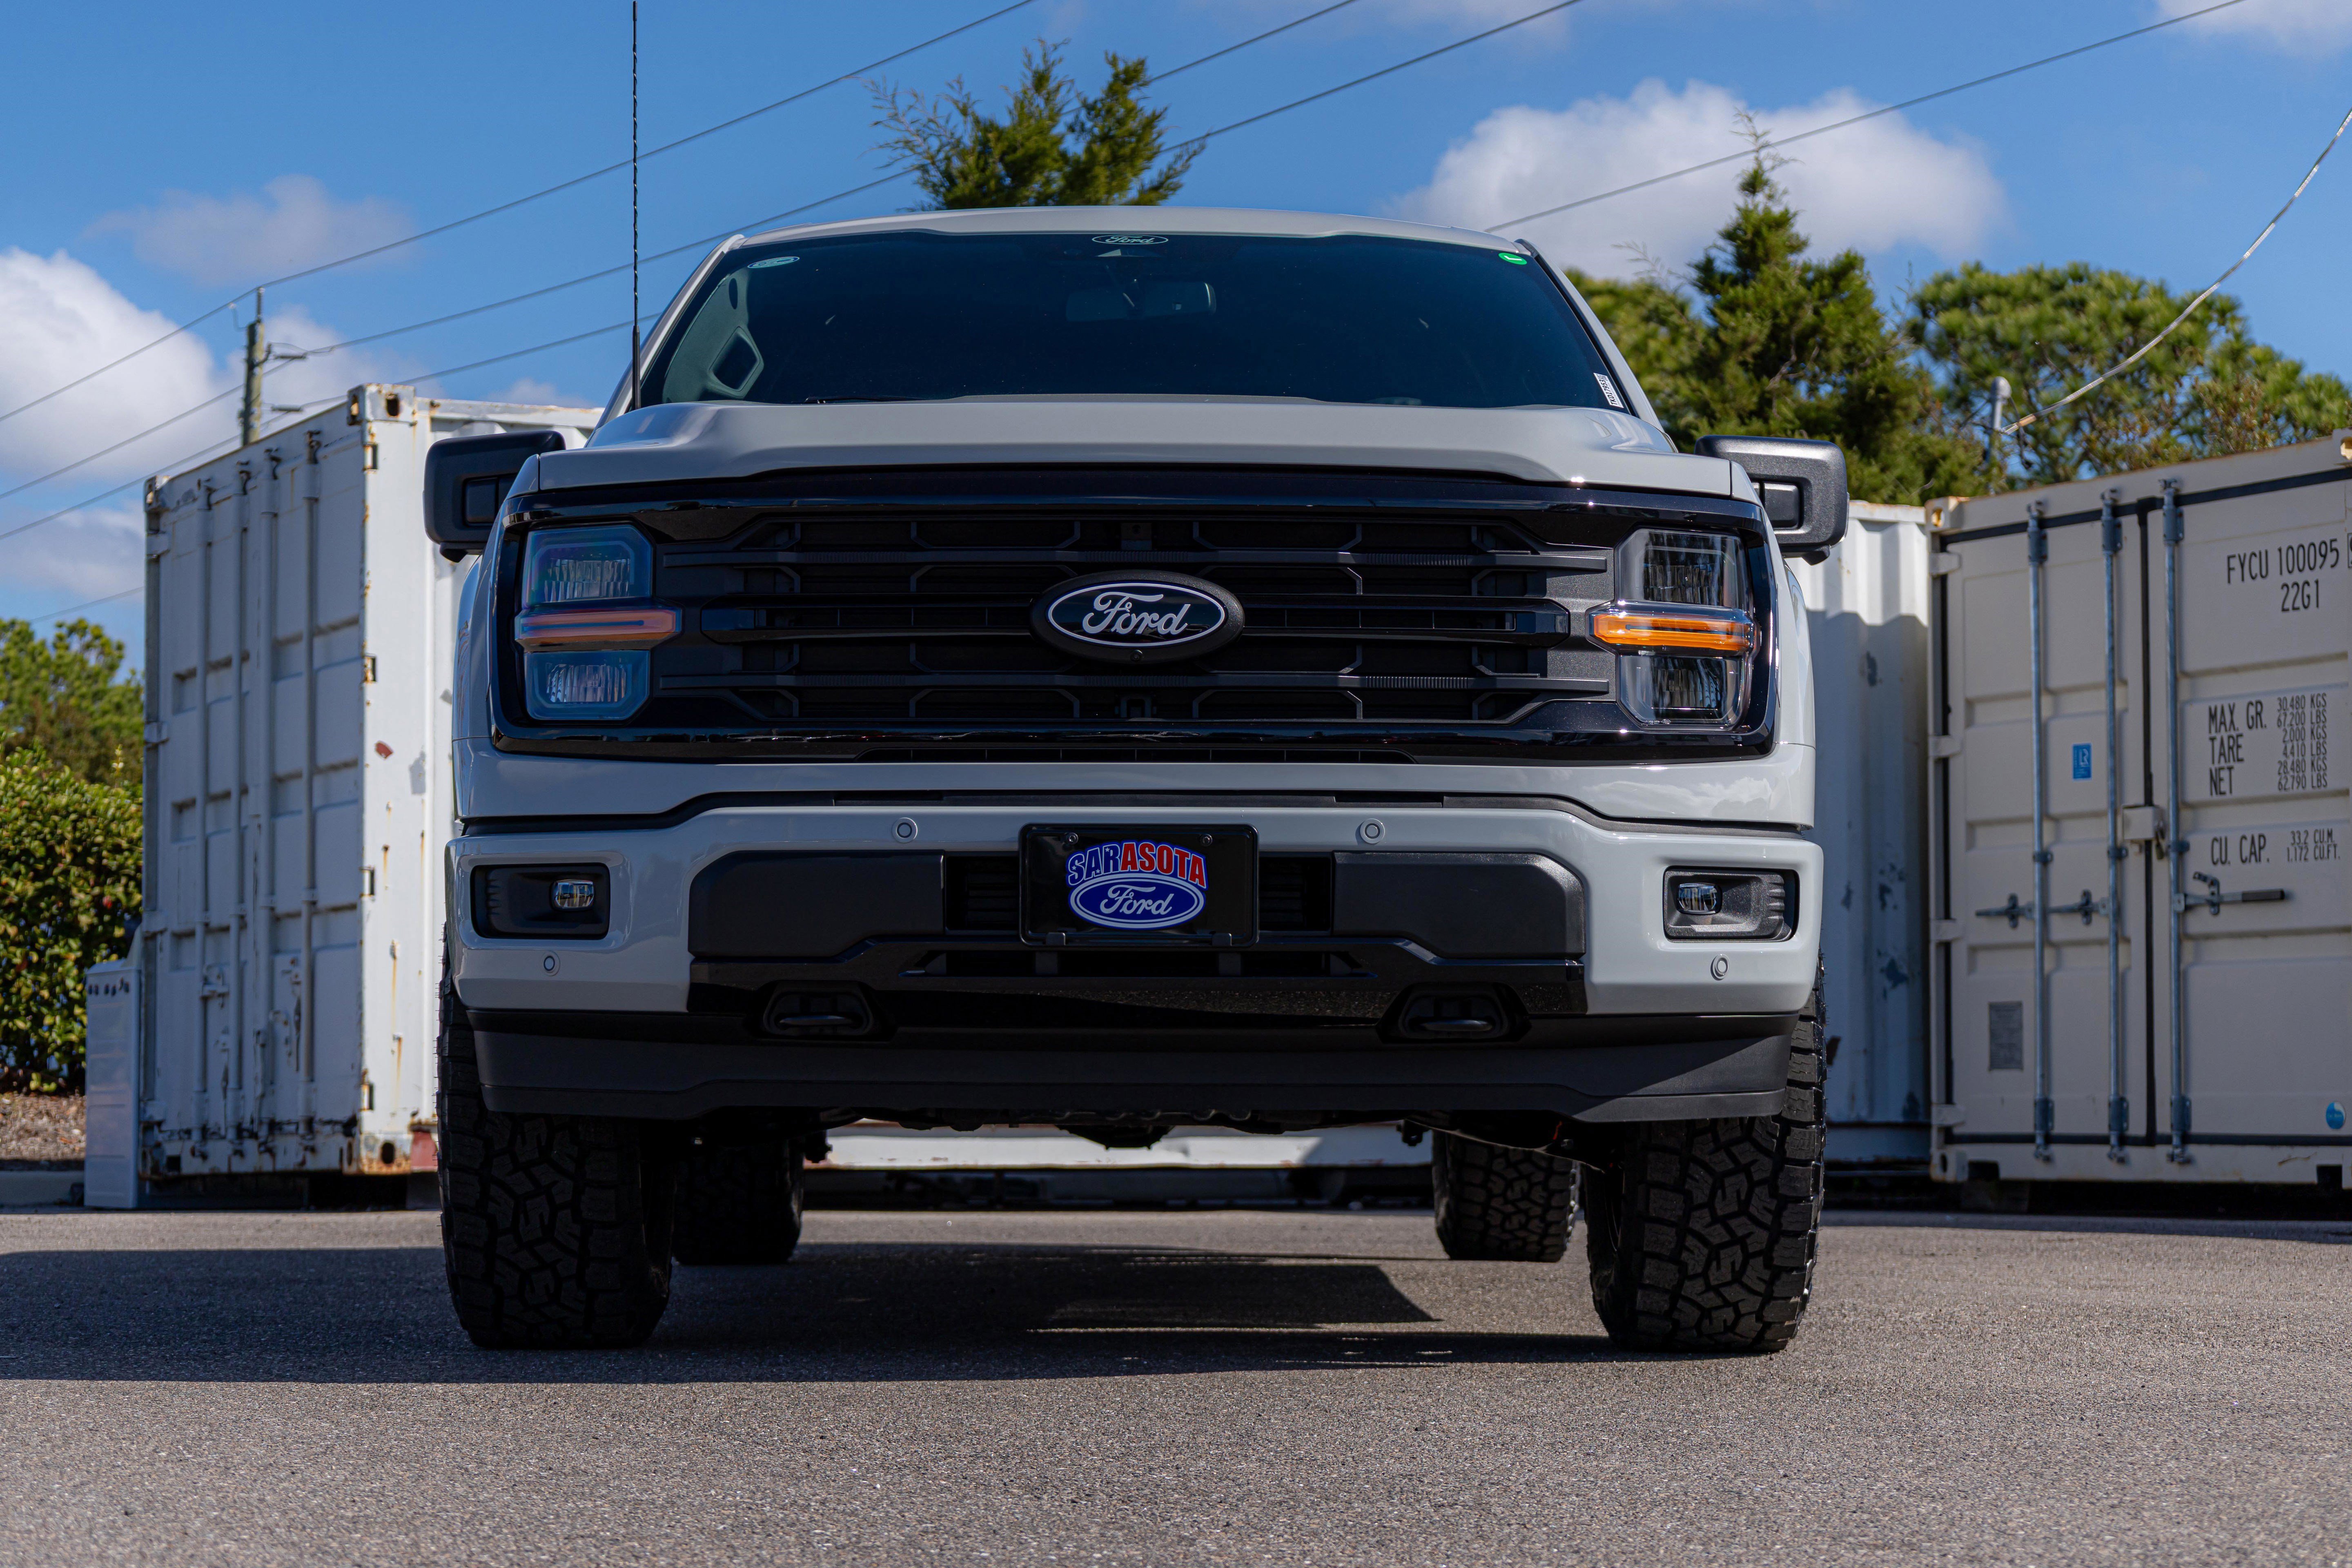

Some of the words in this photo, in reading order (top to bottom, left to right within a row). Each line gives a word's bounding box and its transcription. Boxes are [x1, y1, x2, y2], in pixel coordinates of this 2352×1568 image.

[1105, 235, 1155, 243] Ford
[2227, 549, 2269, 584] FYCU
[2278, 538, 2339, 576] 100095
[2281, 578, 2319, 612] 22G1
[1082, 592, 1191, 635] Ford
[2209, 702, 2239, 734] MAX.
[2247, 699, 2267, 730] GR.
[2310, 693, 2327, 709] KGS
[2310, 708, 2327, 724] LBS
[2209, 733, 2244, 764] TARE
[2310, 724, 2327, 740] KGS
[2310, 740, 2327, 756] LBS
[2209, 765, 2234, 796] NET
[2310, 756, 2327, 772] KGS
[2311, 772, 2328, 788] LBS
[1067, 842, 1207, 888] SARASOTA
[2211, 836, 2231, 865] CU.
[2240, 833, 2270, 864] CAP.
[2290, 829, 2309, 845] 33.2
[1099, 884, 1174, 915] Ford
